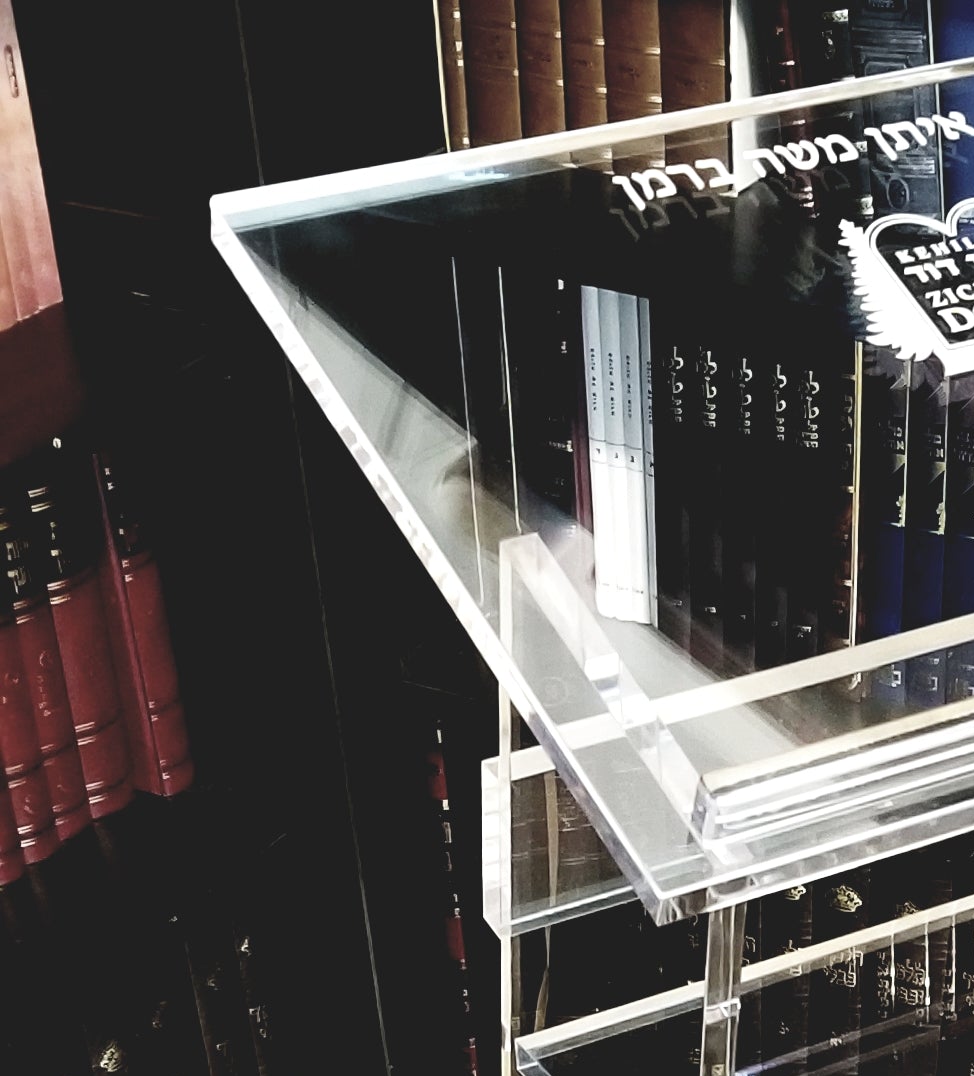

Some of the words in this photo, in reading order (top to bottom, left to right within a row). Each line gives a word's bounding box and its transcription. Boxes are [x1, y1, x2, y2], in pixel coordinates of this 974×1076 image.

[743, 132, 859, 179] משה
[611, 155, 740, 211] ברמן
[903, 258, 960, 283] דוד
